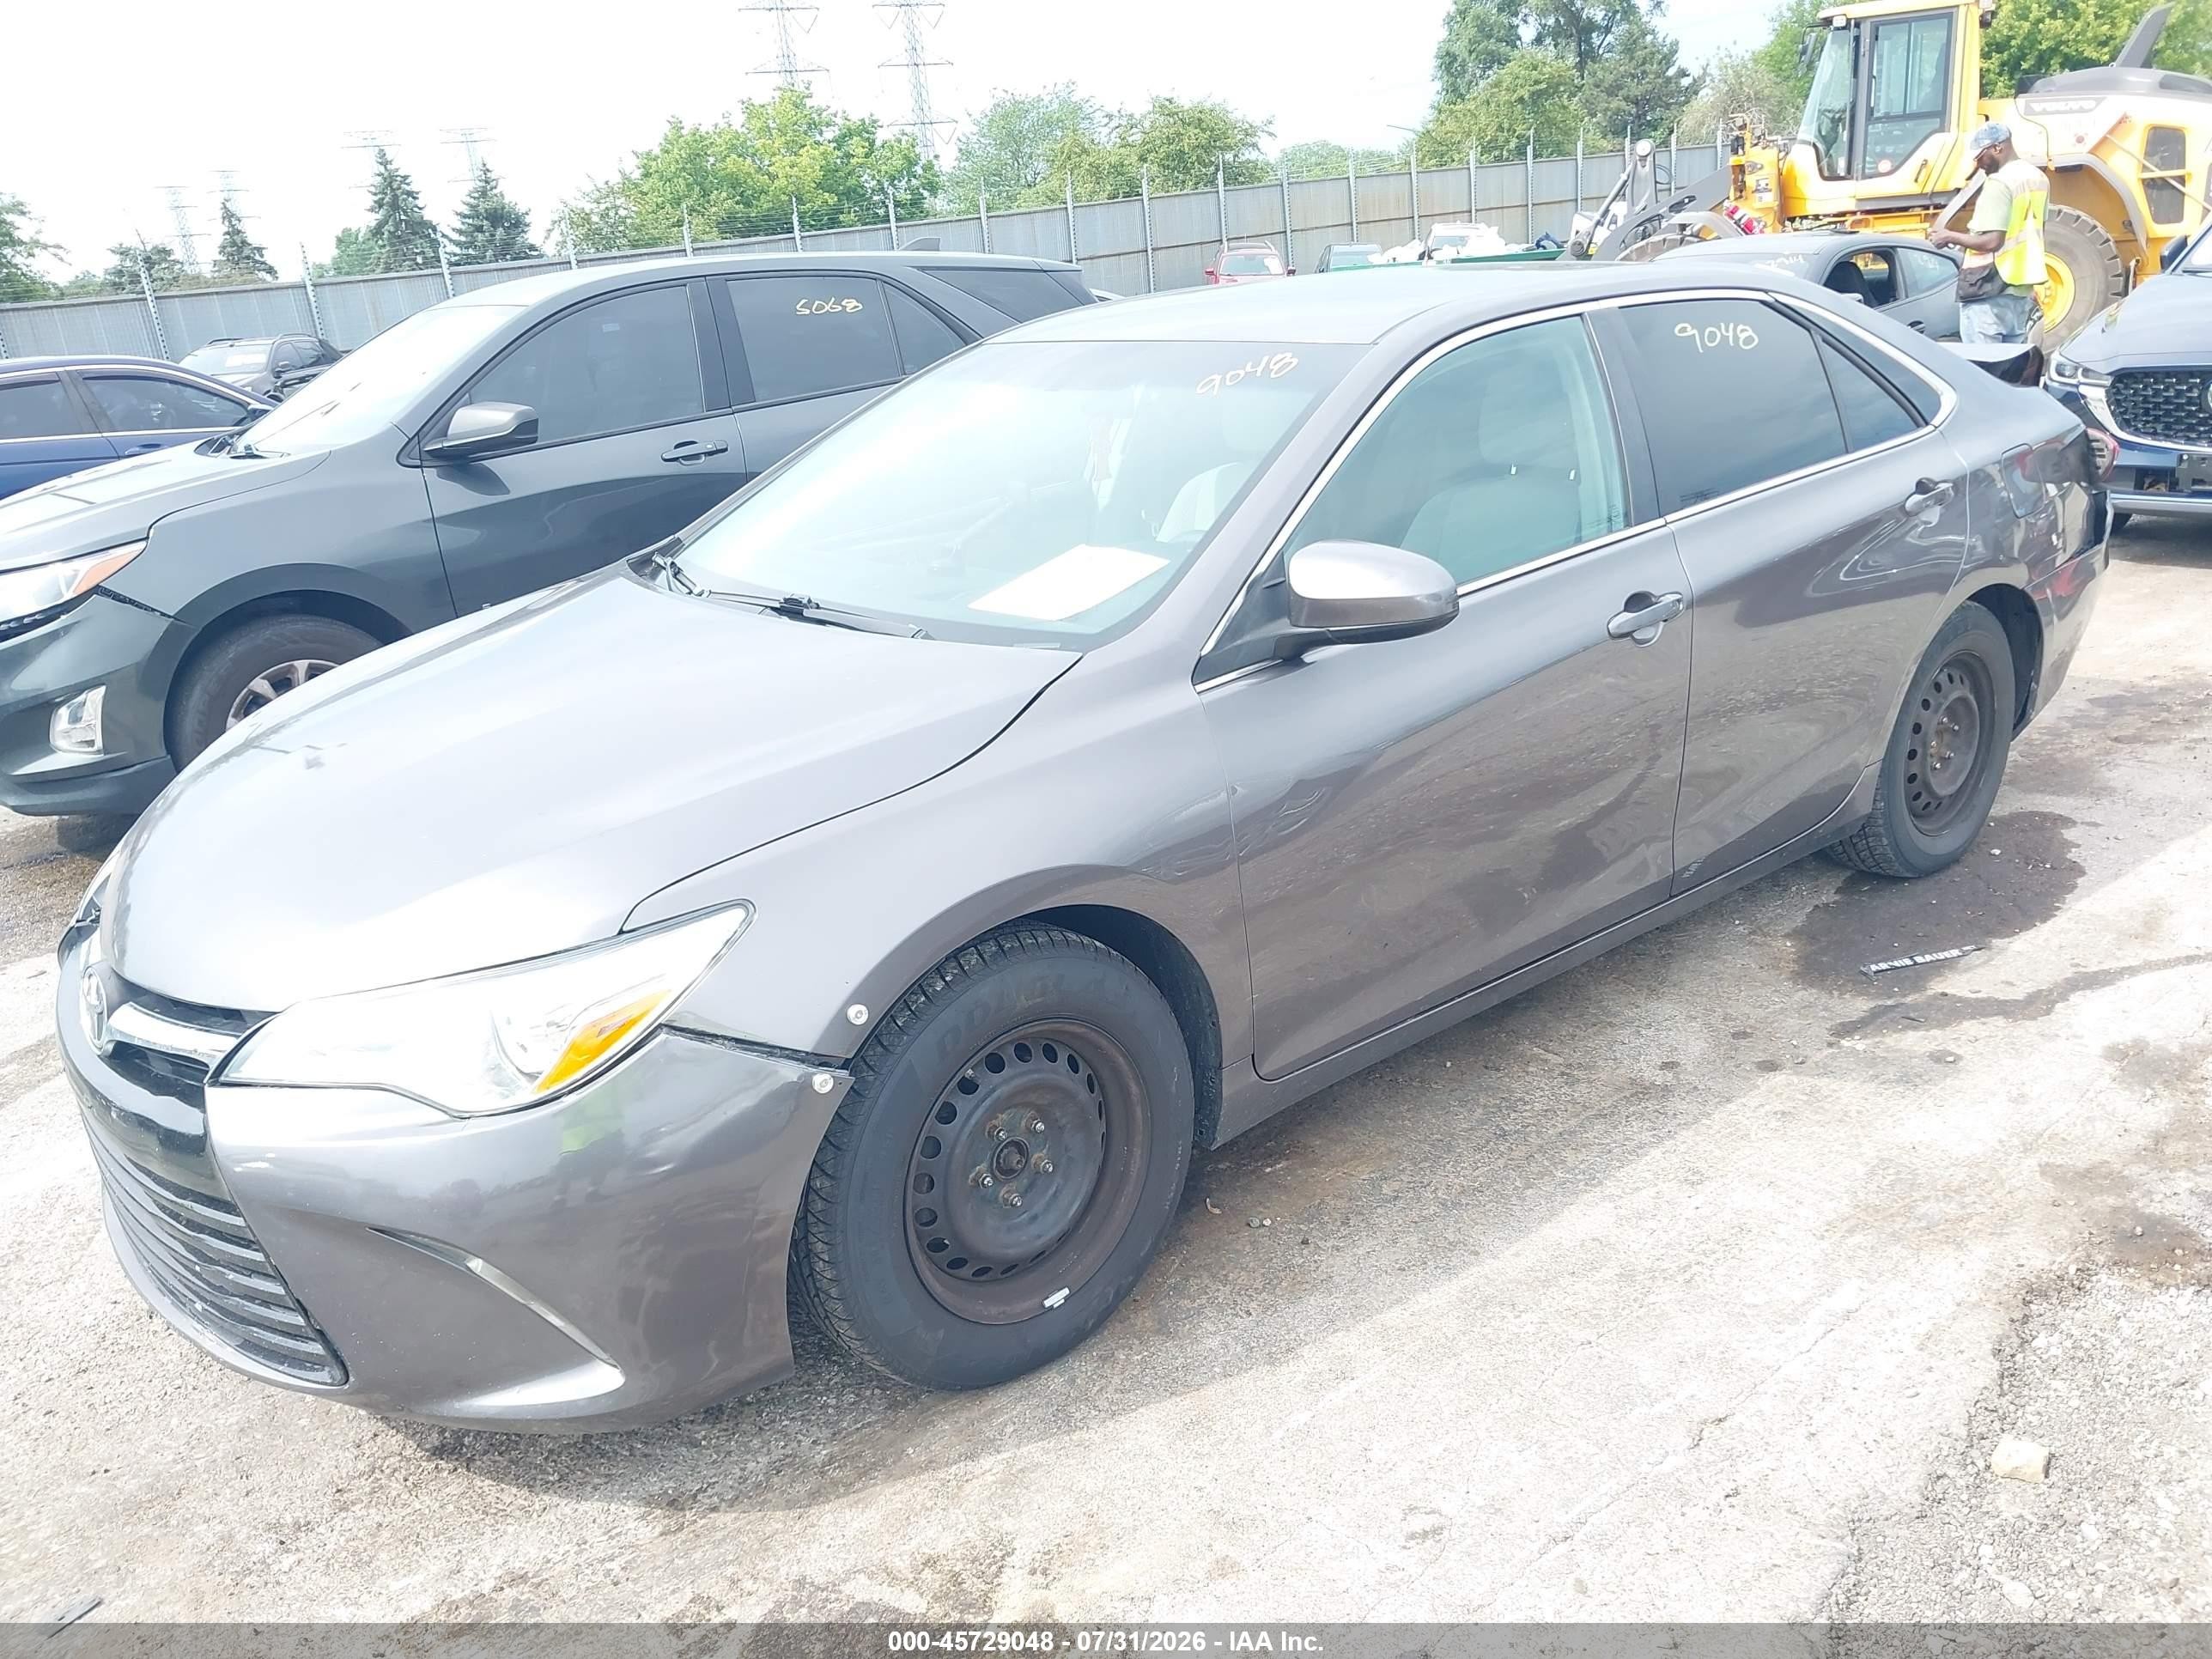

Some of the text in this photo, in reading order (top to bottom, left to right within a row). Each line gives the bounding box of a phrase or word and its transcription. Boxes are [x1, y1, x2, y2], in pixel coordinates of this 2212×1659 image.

[1674, 322, 1759, 353] 9048
[1195, 351, 1299, 395] 9048
[1912, 949, 1963, 963] BAUER
